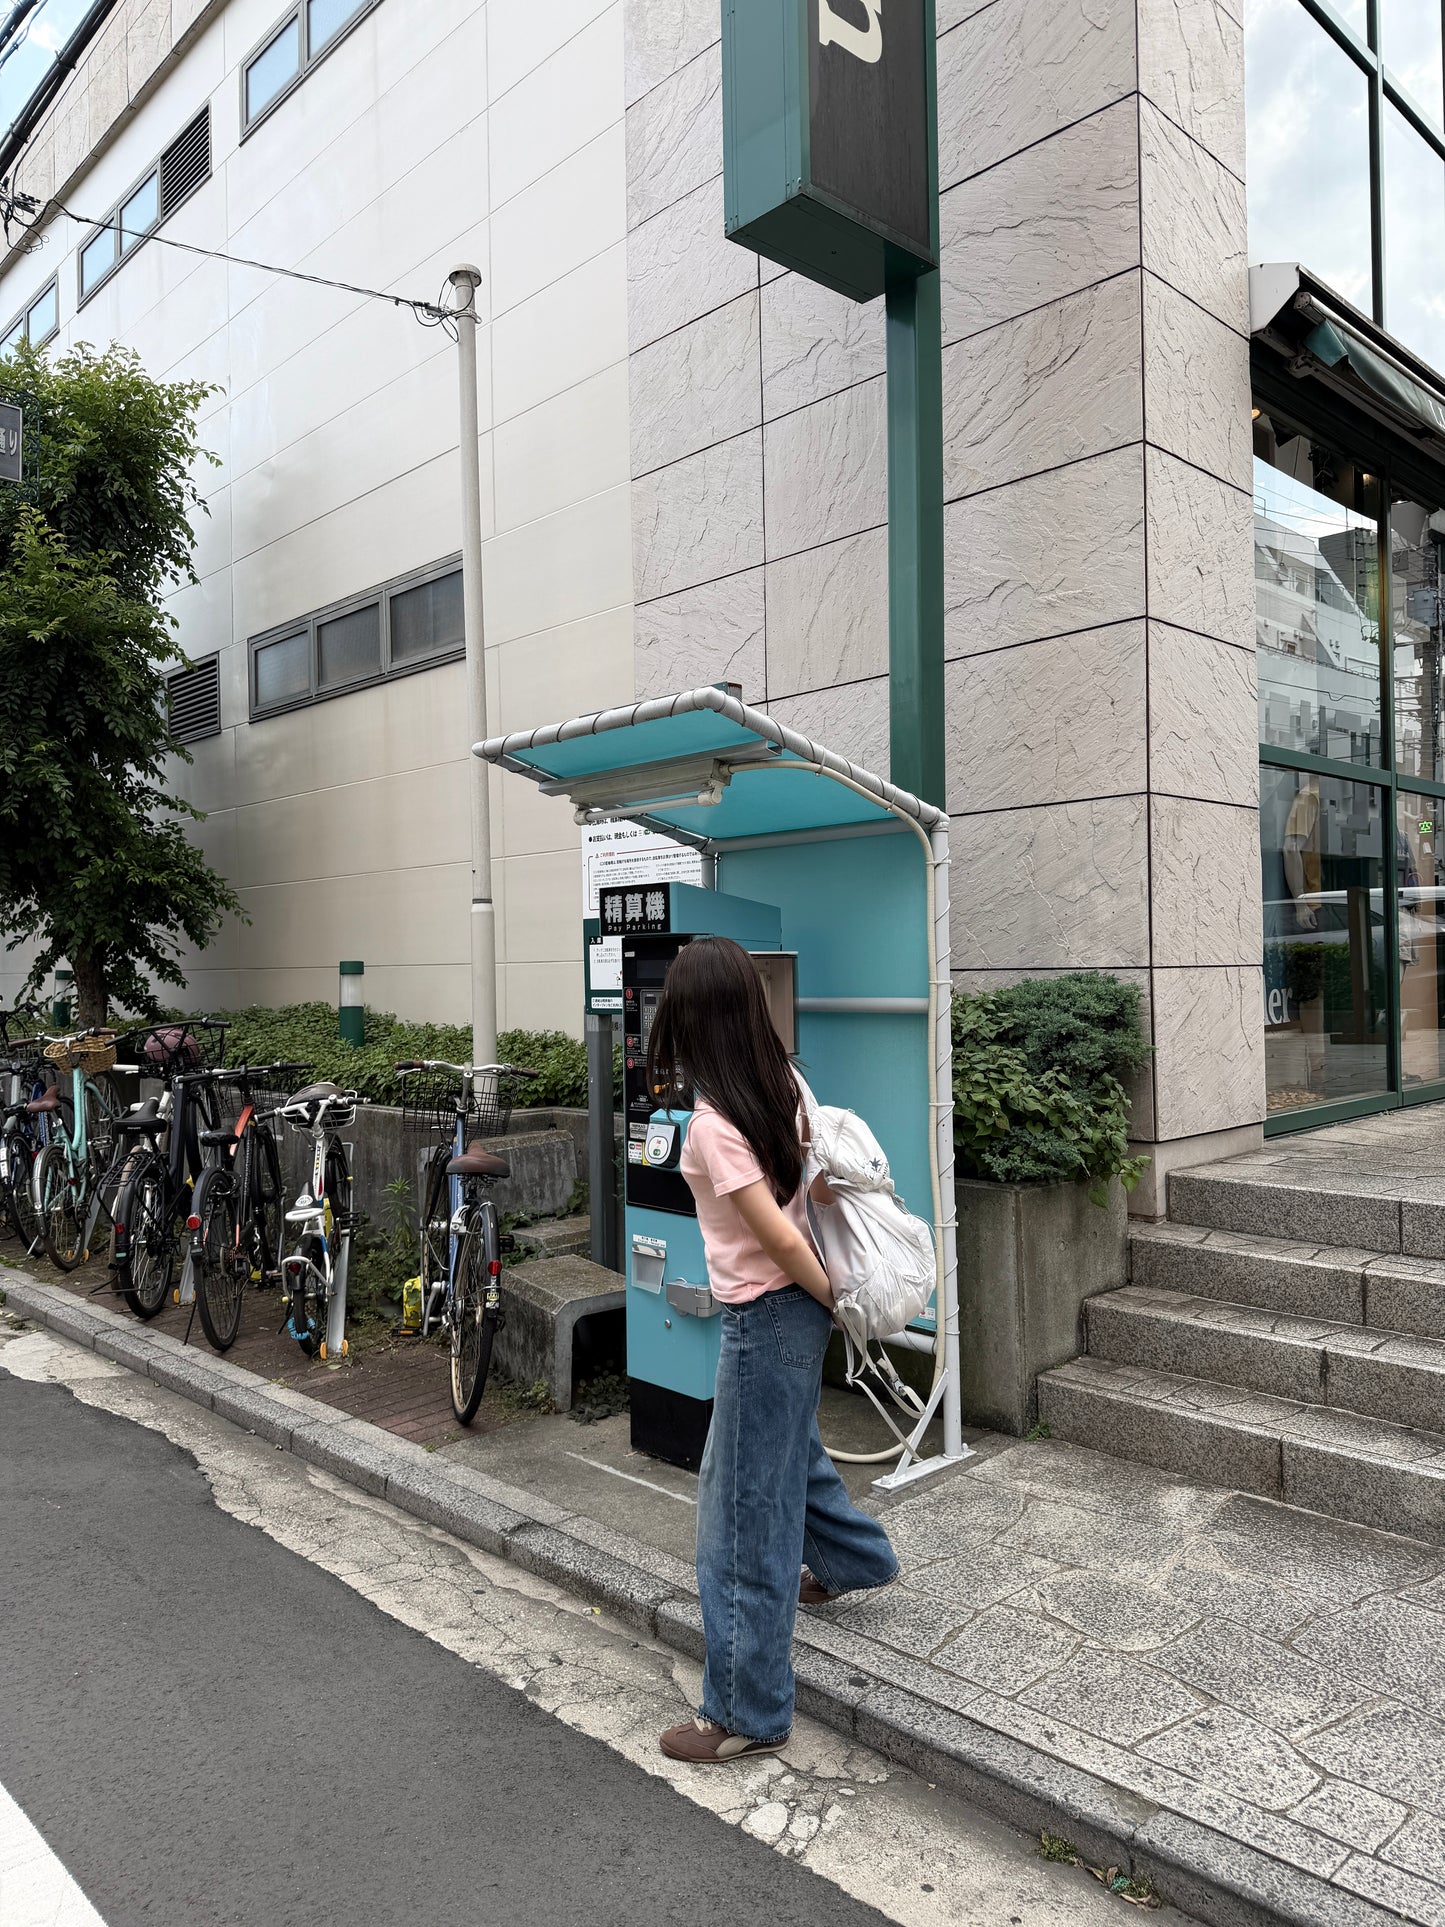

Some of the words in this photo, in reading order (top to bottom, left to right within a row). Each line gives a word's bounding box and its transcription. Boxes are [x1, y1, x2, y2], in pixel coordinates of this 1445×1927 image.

[604, 891, 665, 923] 精算機
[607, 925, 623, 933] Pay
[626, 923, 662, 931] Parking
